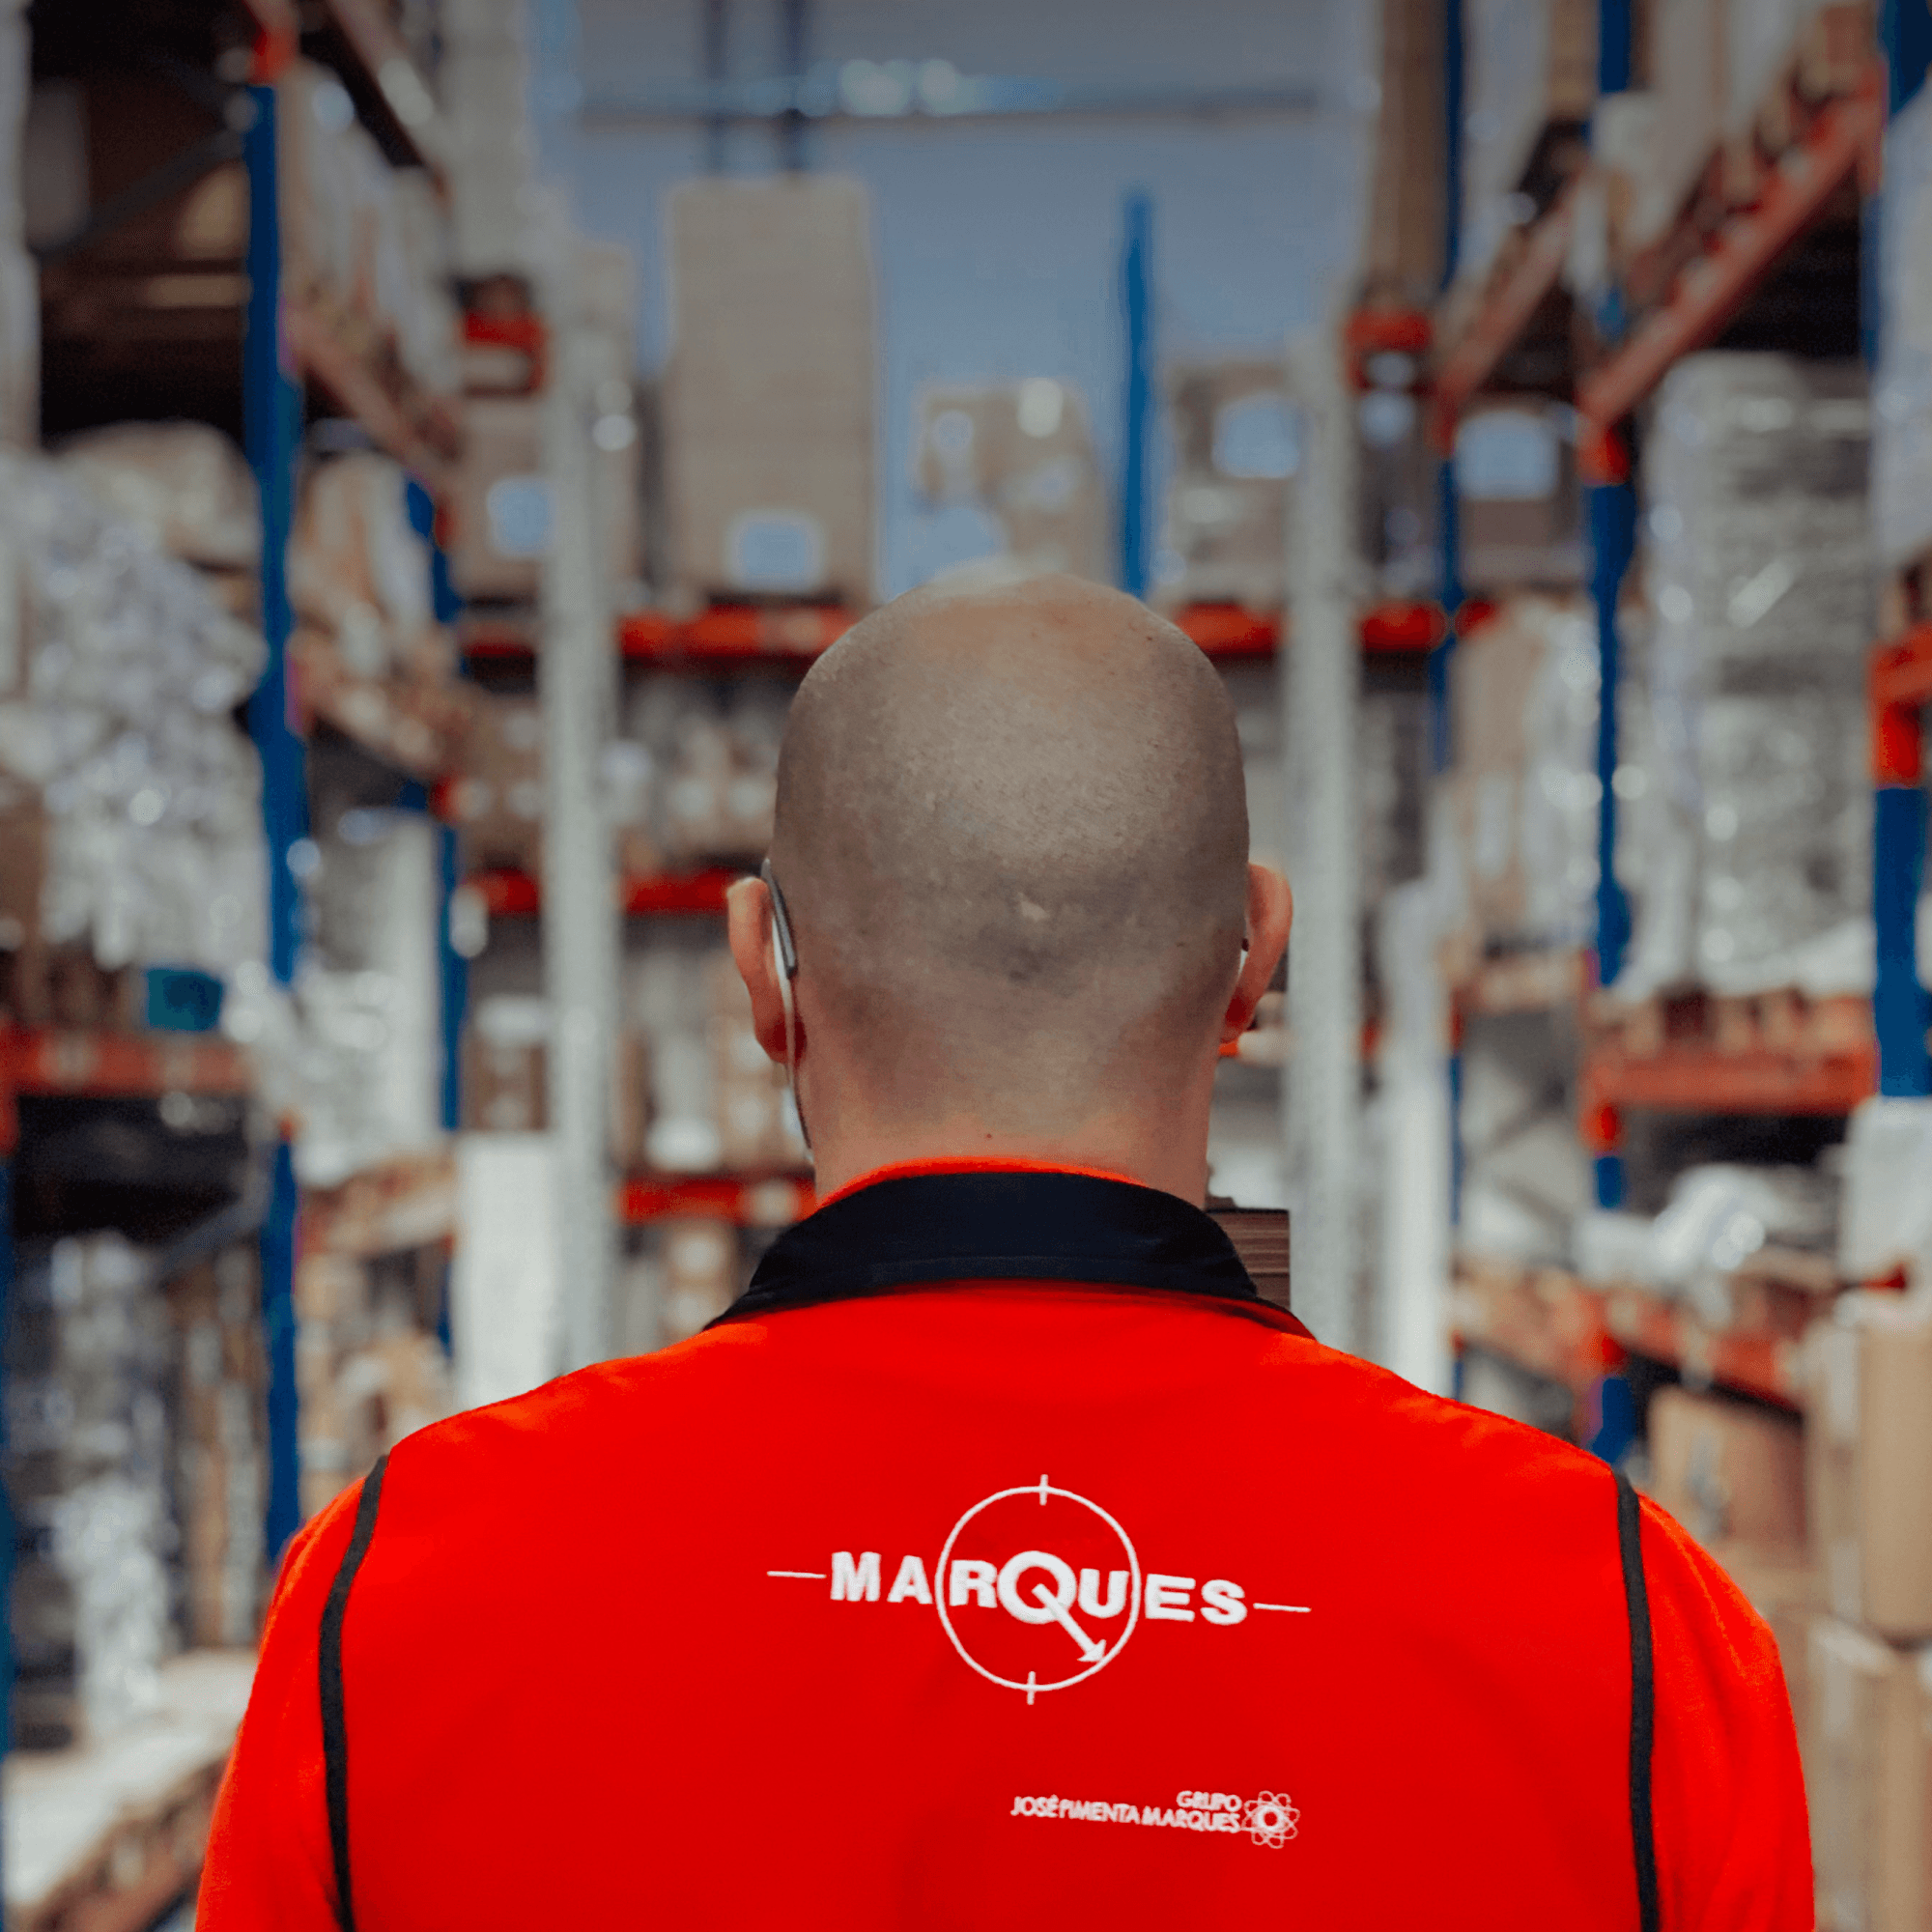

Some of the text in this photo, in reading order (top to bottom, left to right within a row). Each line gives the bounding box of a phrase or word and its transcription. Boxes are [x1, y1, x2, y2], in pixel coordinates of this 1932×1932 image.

[830, 1550, 1248, 1662] MARQUES
[1010, 1794, 1241, 1834] JOSÉ PIMENTA MARQUES
[1176, 1790, 1242, 1812] GRUPO
